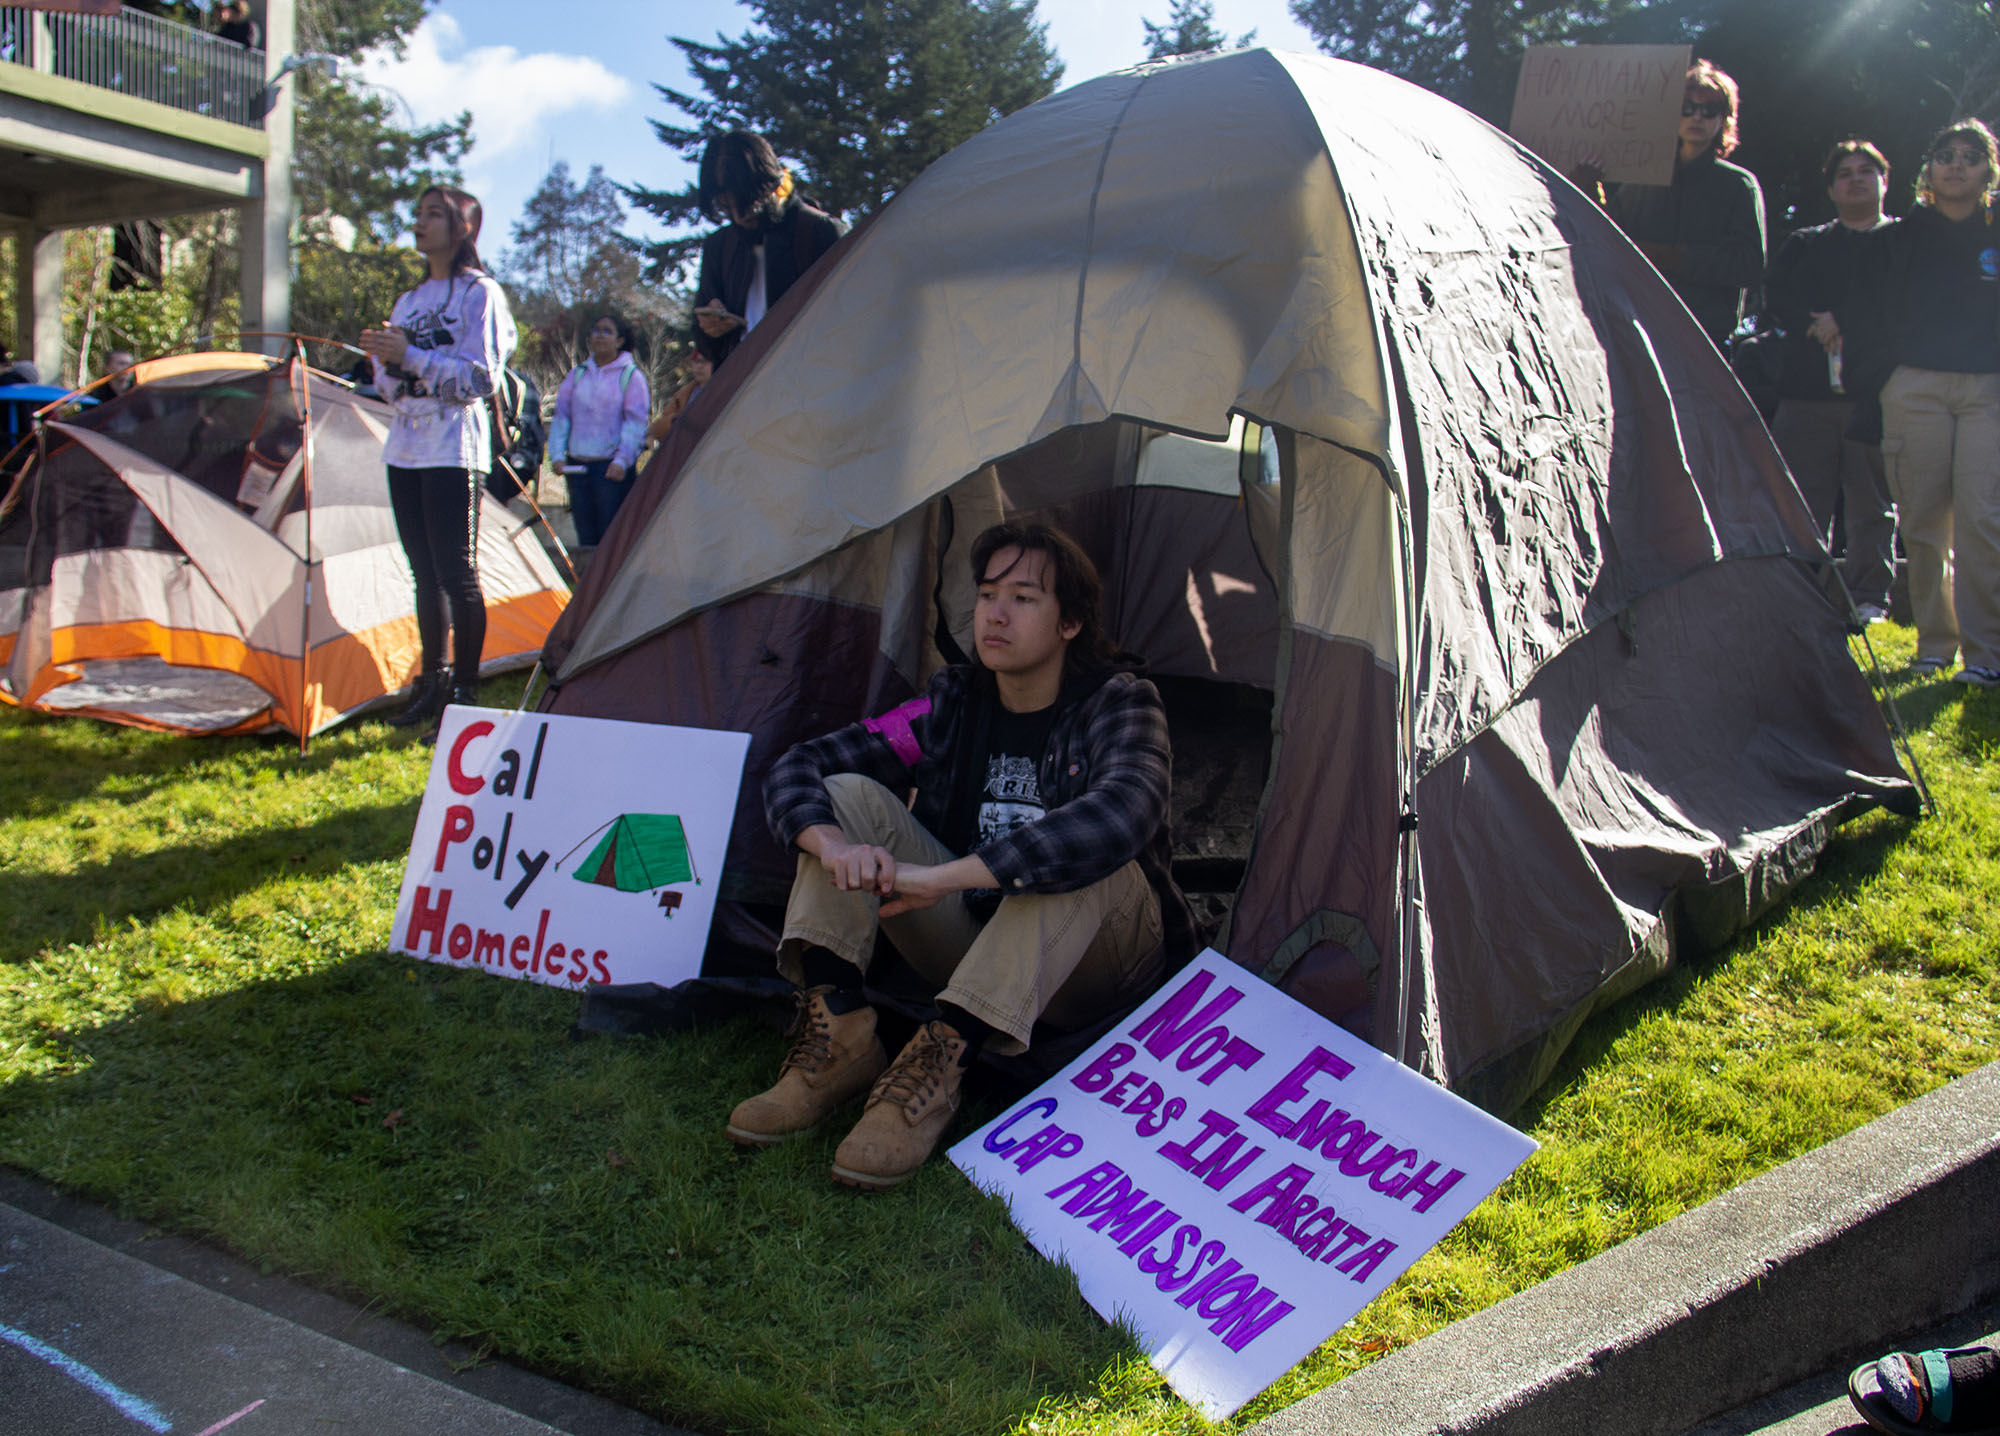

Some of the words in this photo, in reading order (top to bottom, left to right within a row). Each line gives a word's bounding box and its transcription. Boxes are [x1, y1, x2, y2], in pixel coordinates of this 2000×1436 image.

[1523, 54, 1583, 99] HOW
[1584, 57, 1679, 104] MANY
[1551, 99, 1642, 134] MORE
[447, 720, 549, 800] Cal
[433, 804, 550, 911] Poly
[404, 885, 612, 985] Homeless
[1128, 968, 1265, 1087] NOT
[1244, 1045, 1468, 1214] ENOUGH
[1070, 1042, 1187, 1138] BEDS
[1157, 1109, 1266, 1192] IN
[1228, 1163, 1399, 1285] ARCATA
[982, 1097, 1084, 1174] CAP
[1045, 1160, 1296, 1354] ADMISSION
